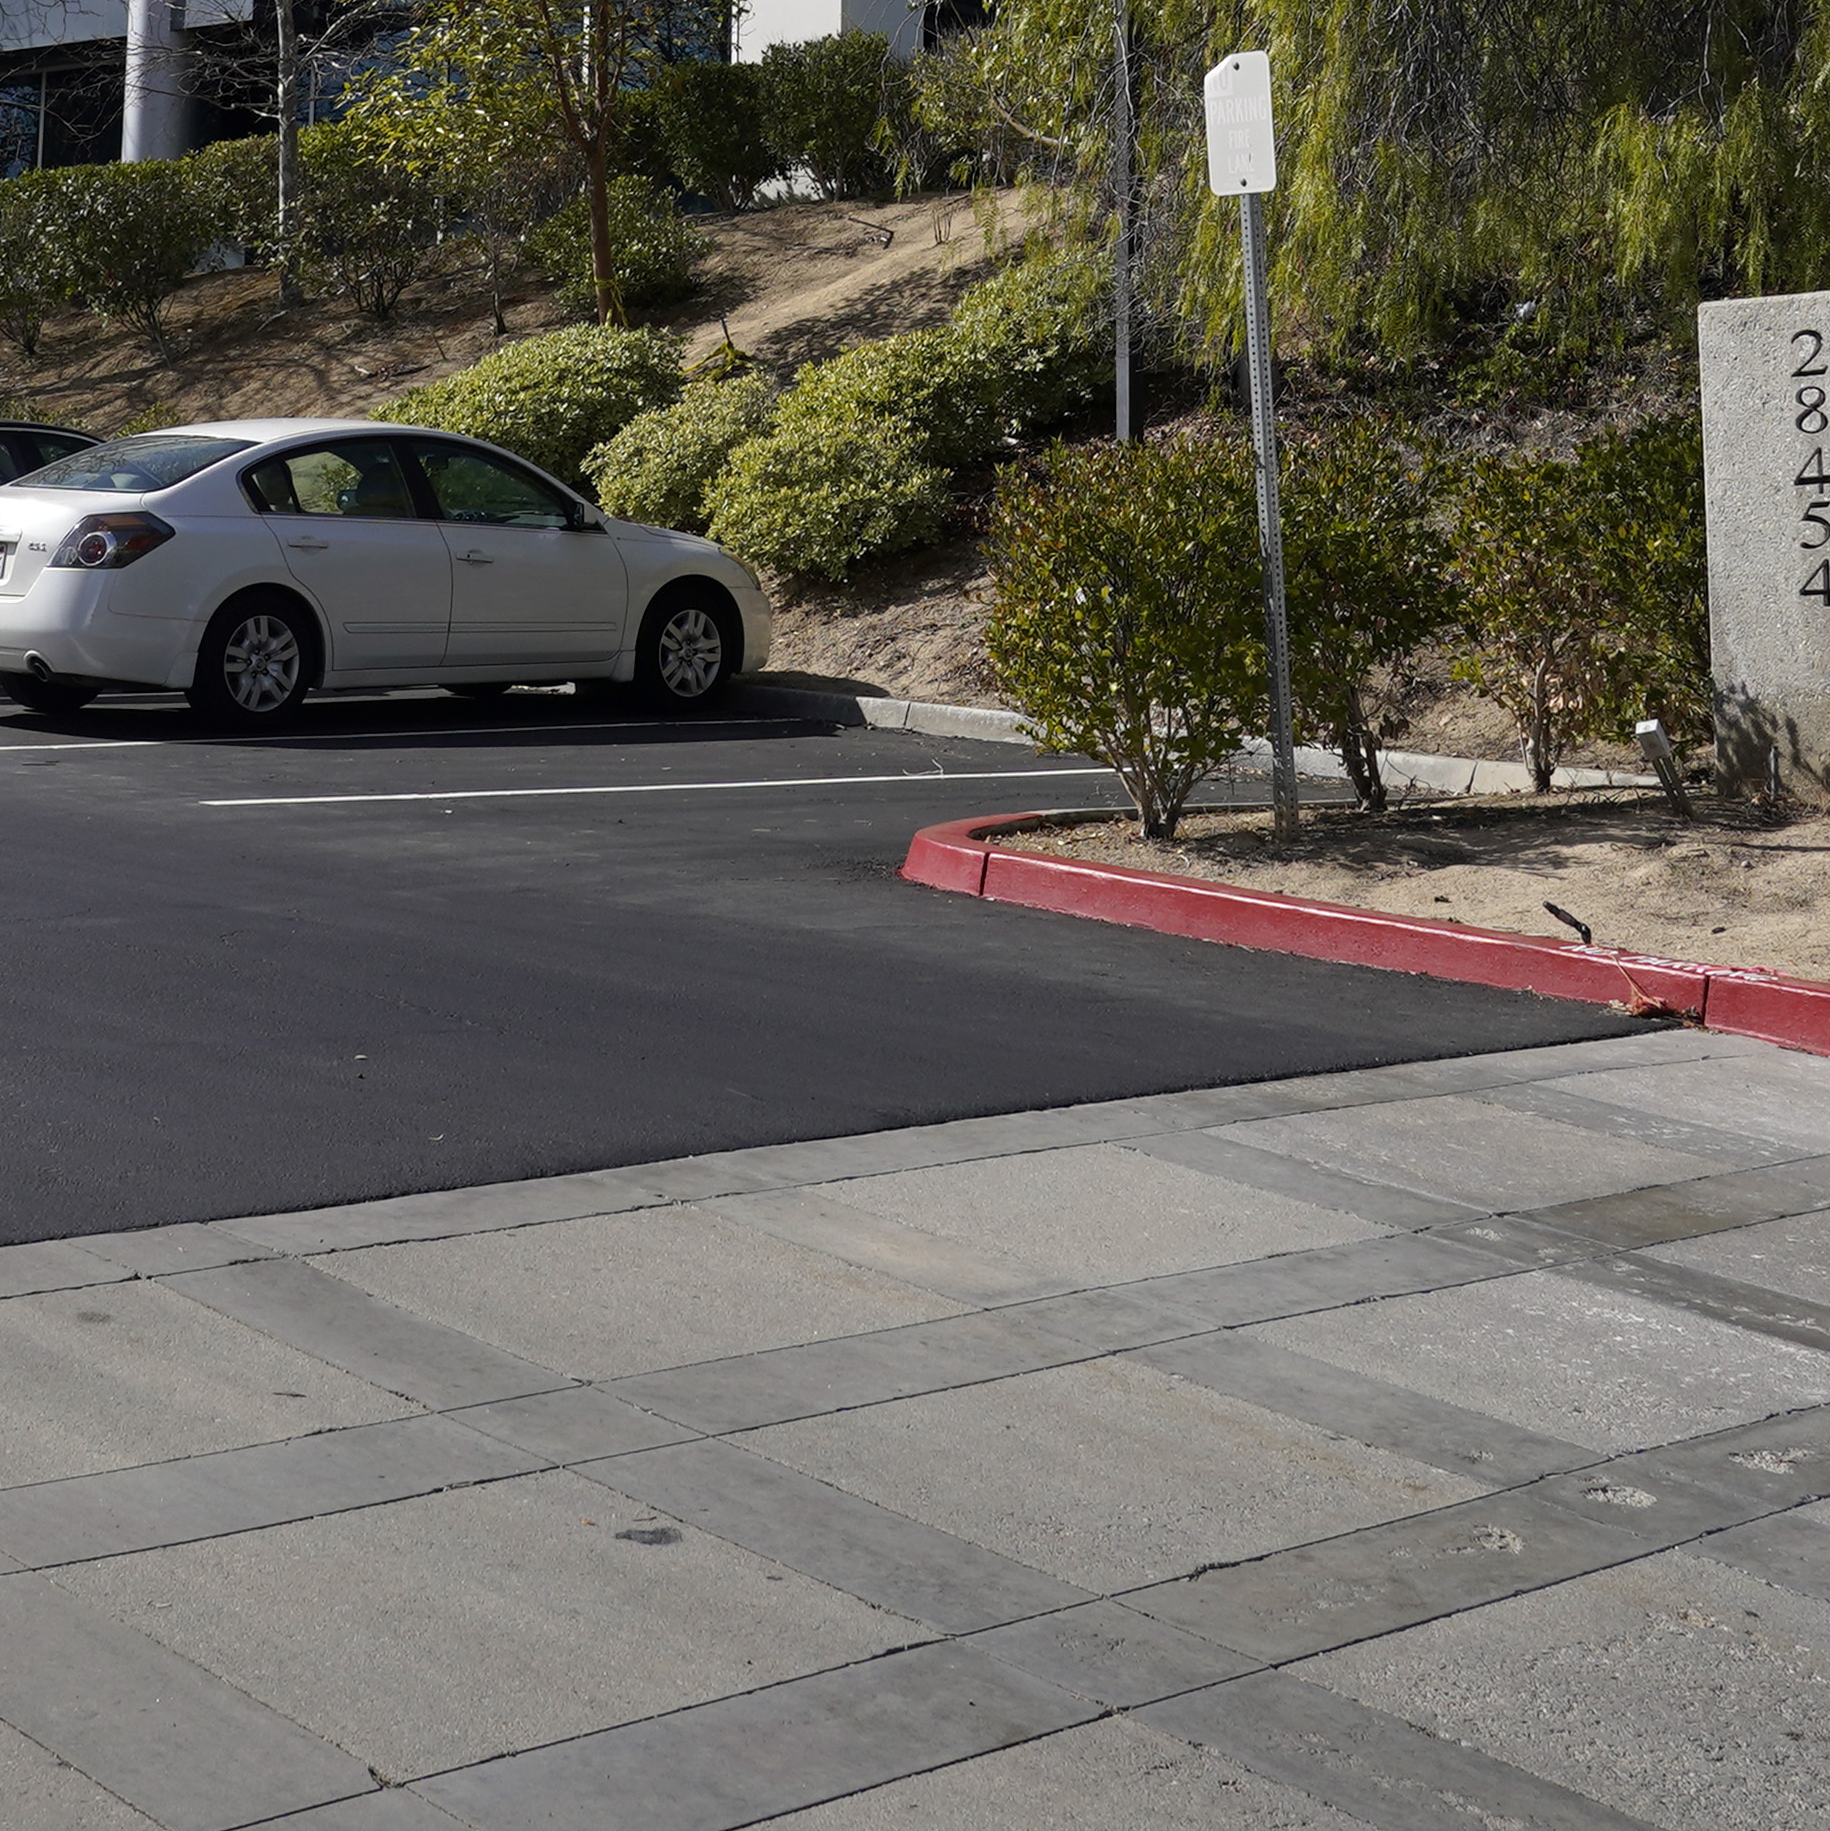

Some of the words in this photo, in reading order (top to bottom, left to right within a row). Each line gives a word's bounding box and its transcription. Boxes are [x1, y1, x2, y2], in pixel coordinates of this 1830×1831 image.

[1209, 95, 1268, 125] PARKING
[1228, 129, 1250, 148] FIRE
[1227, 152, 1255, 174] LANE
